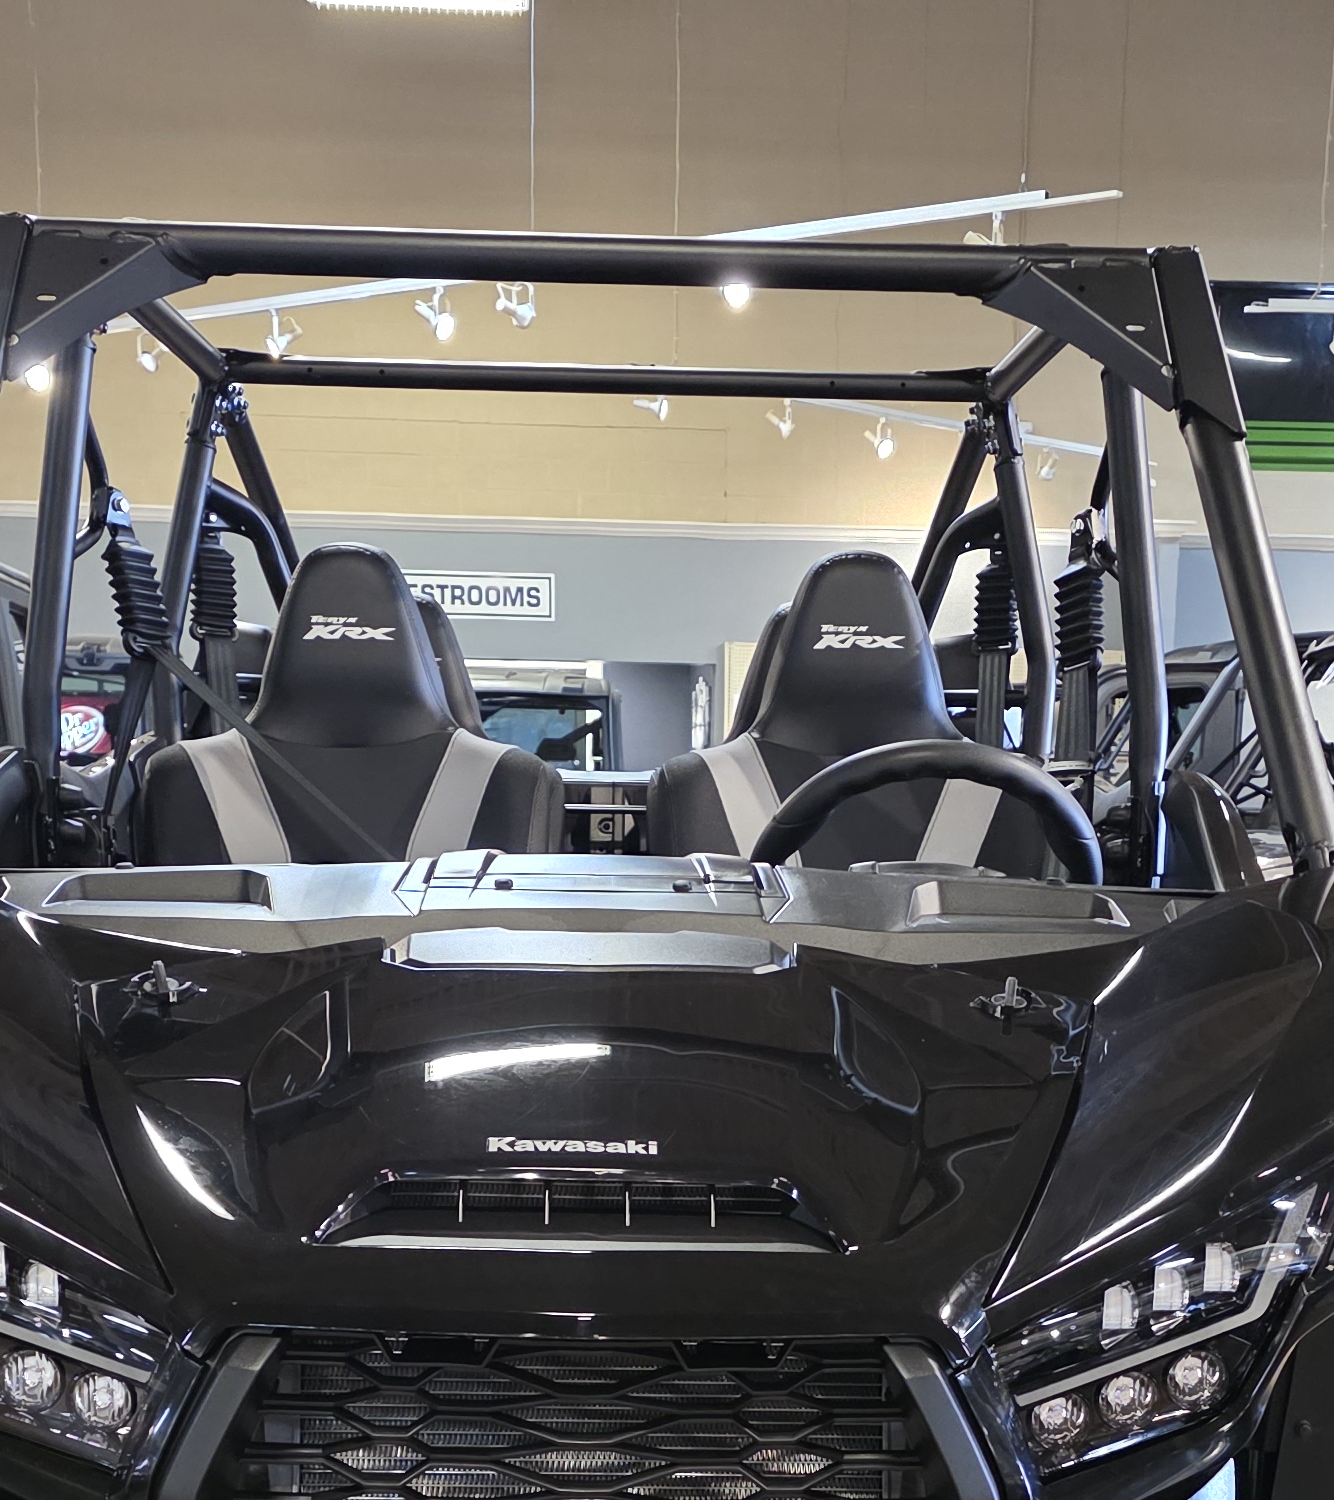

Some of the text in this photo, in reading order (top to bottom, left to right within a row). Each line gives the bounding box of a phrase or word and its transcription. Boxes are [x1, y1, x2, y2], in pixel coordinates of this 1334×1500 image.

[408, 584, 541, 608] STROOMS
[302, 624, 397, 641] KRX
[813, 633, 906, 650] KRX
[486, 1136, 658, 1155] Kawasaki
